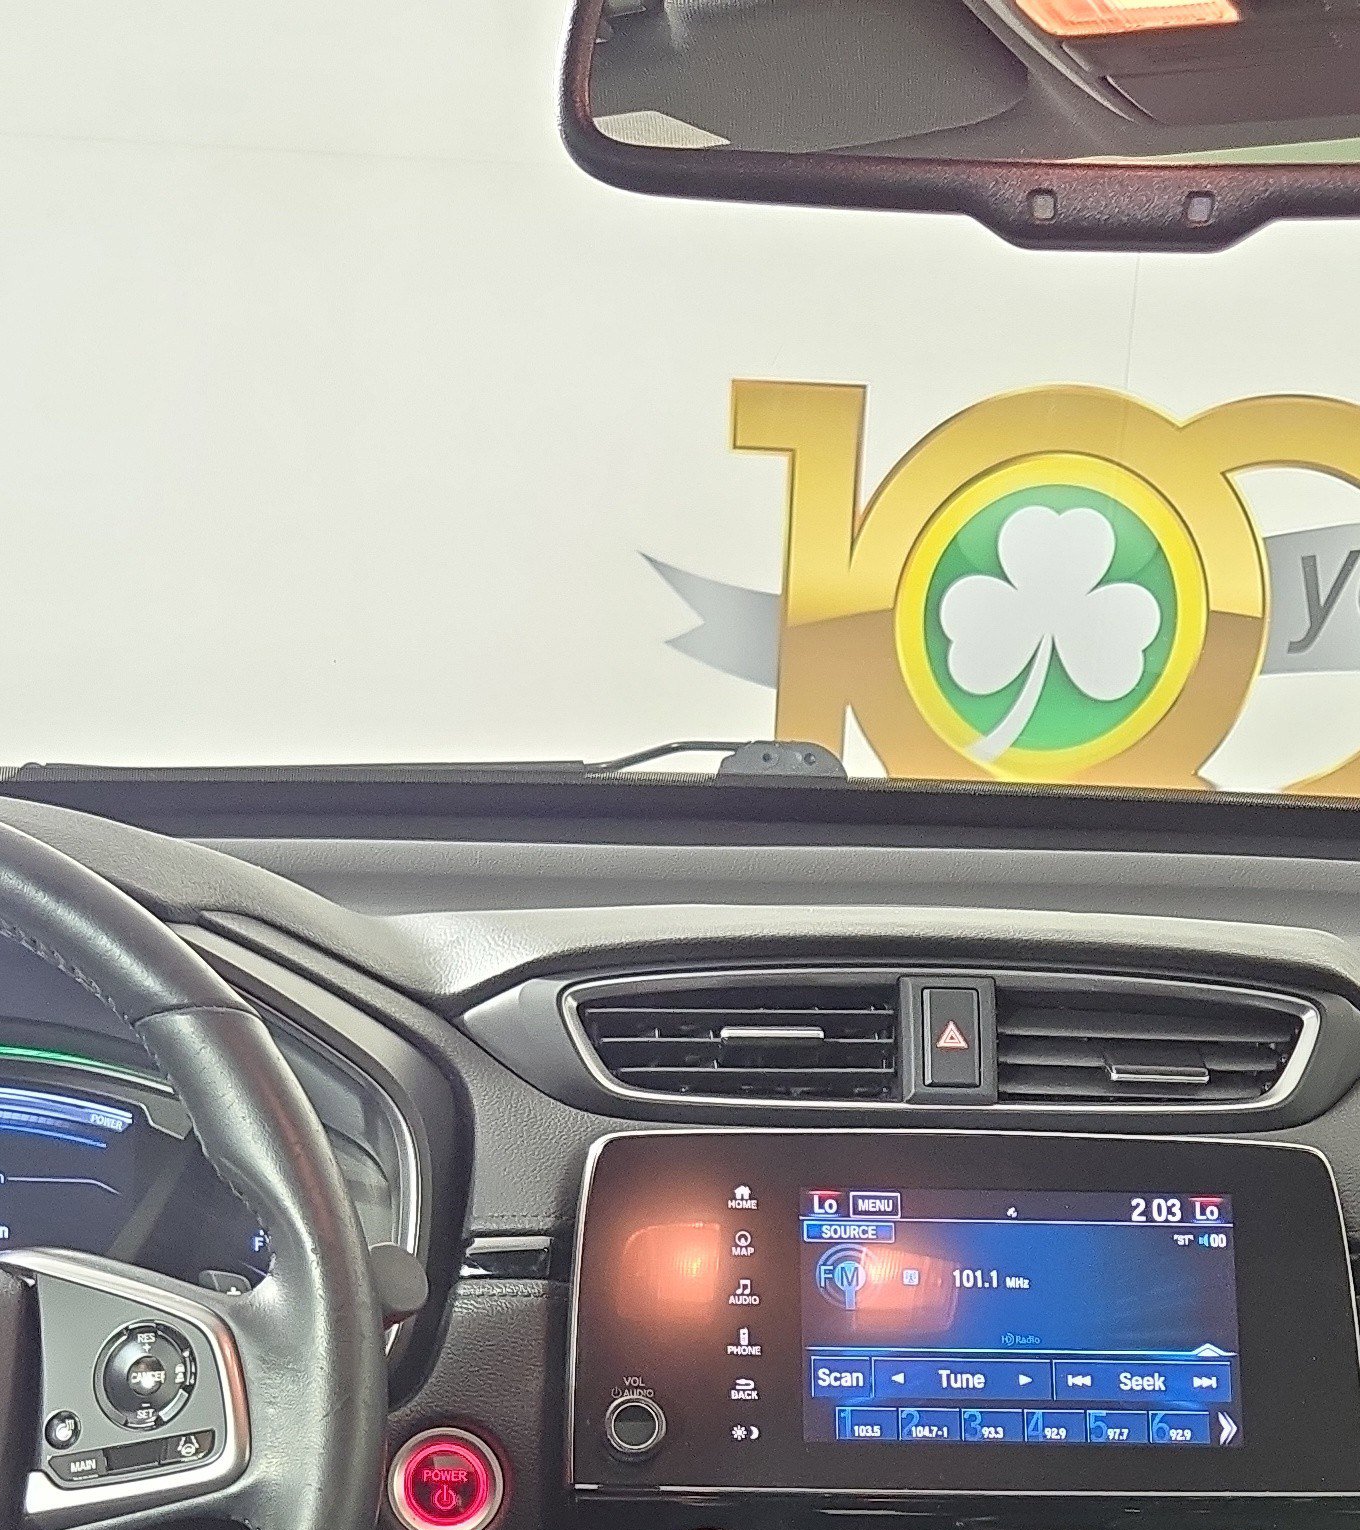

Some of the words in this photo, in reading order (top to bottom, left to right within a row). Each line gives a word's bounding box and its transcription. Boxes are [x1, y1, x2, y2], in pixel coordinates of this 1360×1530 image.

[90, 1113, 123, 1131] POWER
[728, 1199, 758, 1209] HOME
[813, 1194, 838, 1214] Lo
[858, 1199, 893, 1212] MENU
[1195, 1201, 1219, 1220] Lo
[821, 1225, 877, 1239] SOURCE
[1210, 1233, 1227, 1248] 00
[731, 1246, 755, 1256] MAP
[819, 1265, 860, 1288] FM
[952, 1269, 999, 1288] 101.1
[1005, 1277, 1031, 1289] MHz
[728, 1294, 760, 1305] AUDIO
[137, 1332, 156, 1343] RES
[1015, 1334, 1041, 1345] Radio
[727, 1345, 762, 1355] PHONE
[622, 1376, 646, 1387] VOL
[817, 1367, 864, 1387] Scan
[938, 1369, 986, 1389] Tune
[1119, 1371, 1166, 1391] Seek
[623, 1388, 654, 1398] AUDIO
[730, 1390, 759, 1400] BACK
[136, 1408, 156, 1419] SET
[853, 1425, 881, 1437] 103.5
[1044, 1427, 1067, 1439] 92.9
[1169, 1428, 1192, 1441] 92.9
[69, 1458, 97, 1473] MAIN
[423, 1469, 468, 1482] POWER
